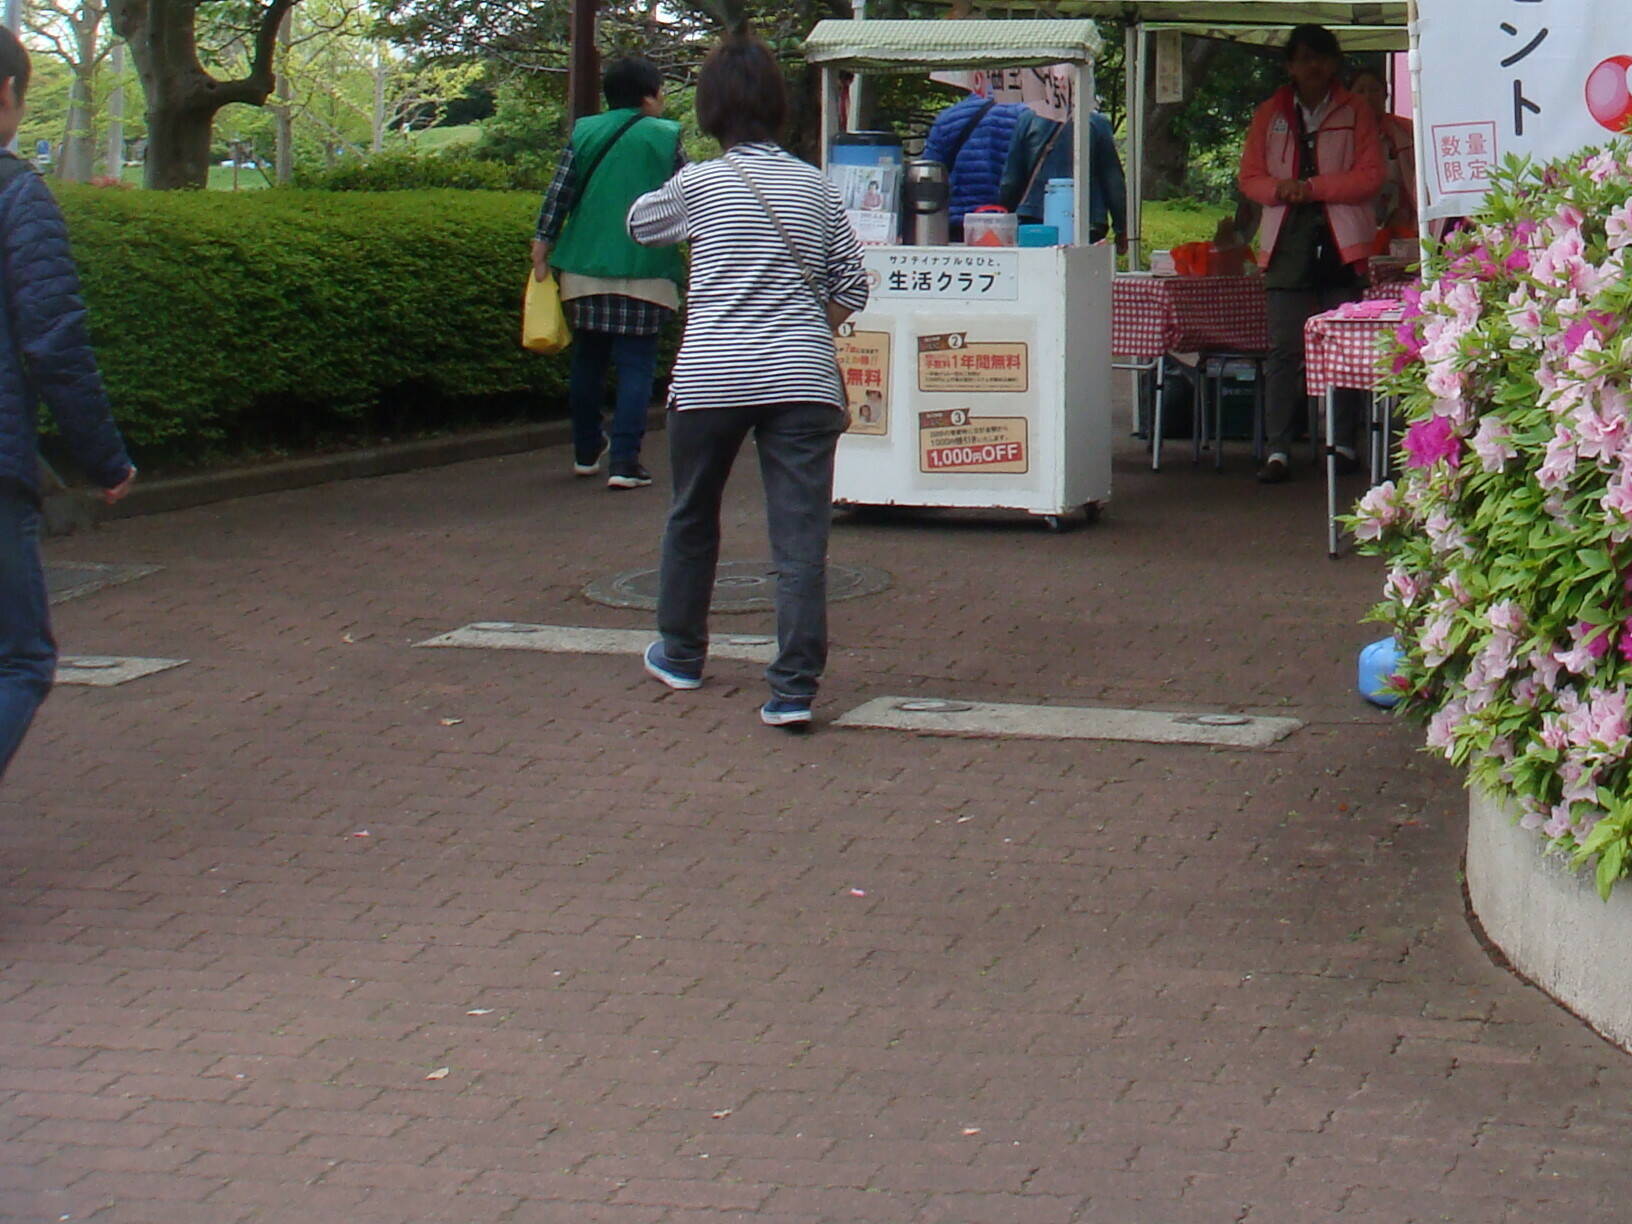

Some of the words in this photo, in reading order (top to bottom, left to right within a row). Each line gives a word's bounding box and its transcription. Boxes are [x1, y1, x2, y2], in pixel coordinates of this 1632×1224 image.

[1441, 133, 1487, 158] 数量
[1444, 159, 1489, 182] 限定
[888, 270, 1001, 293] 生活クラブ
